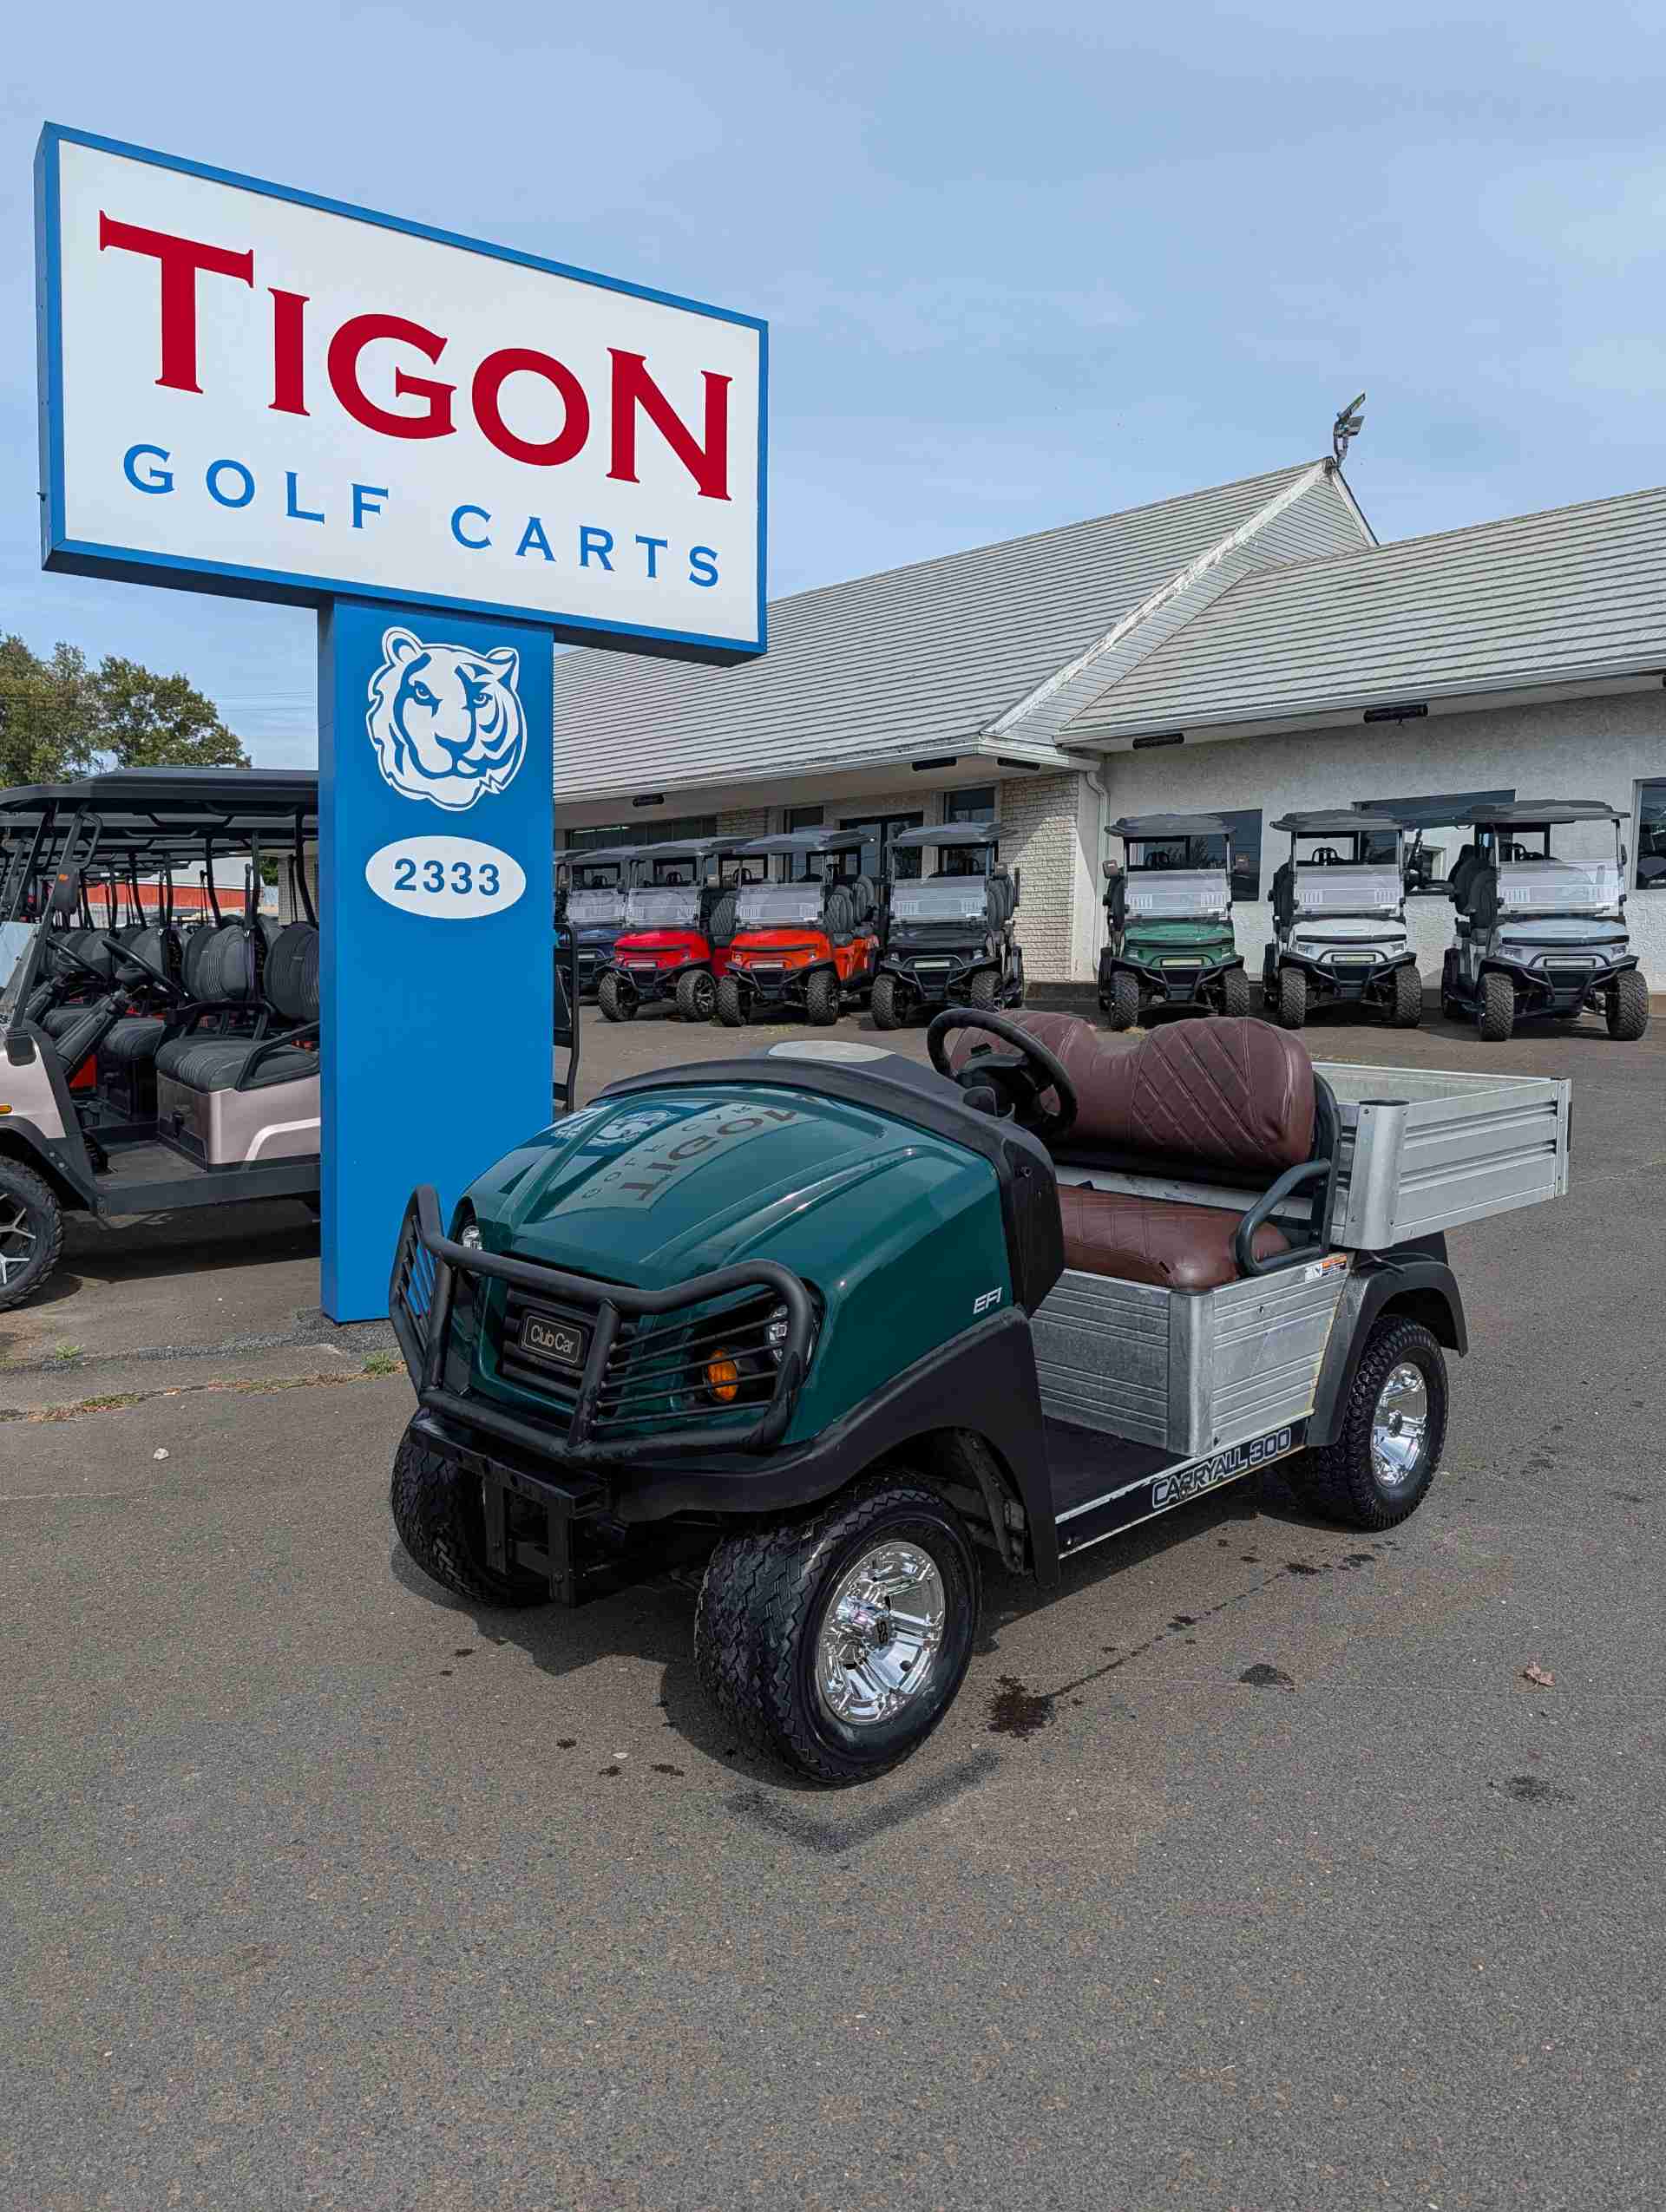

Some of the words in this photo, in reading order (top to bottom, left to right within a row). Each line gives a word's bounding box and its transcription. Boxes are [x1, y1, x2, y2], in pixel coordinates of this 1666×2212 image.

[100, 210, 732, 501] TIGON
[123, 444, 389, 529] GOLF
[450, 505, 719, 587] CARTS
[394, 859, 501, 896] 2333
[973, 1286, 1002, 1314] EFI
[1151, 1448, 1249, 1508] CARRYALL
[1249, 1427, 1291, 1465] 300
